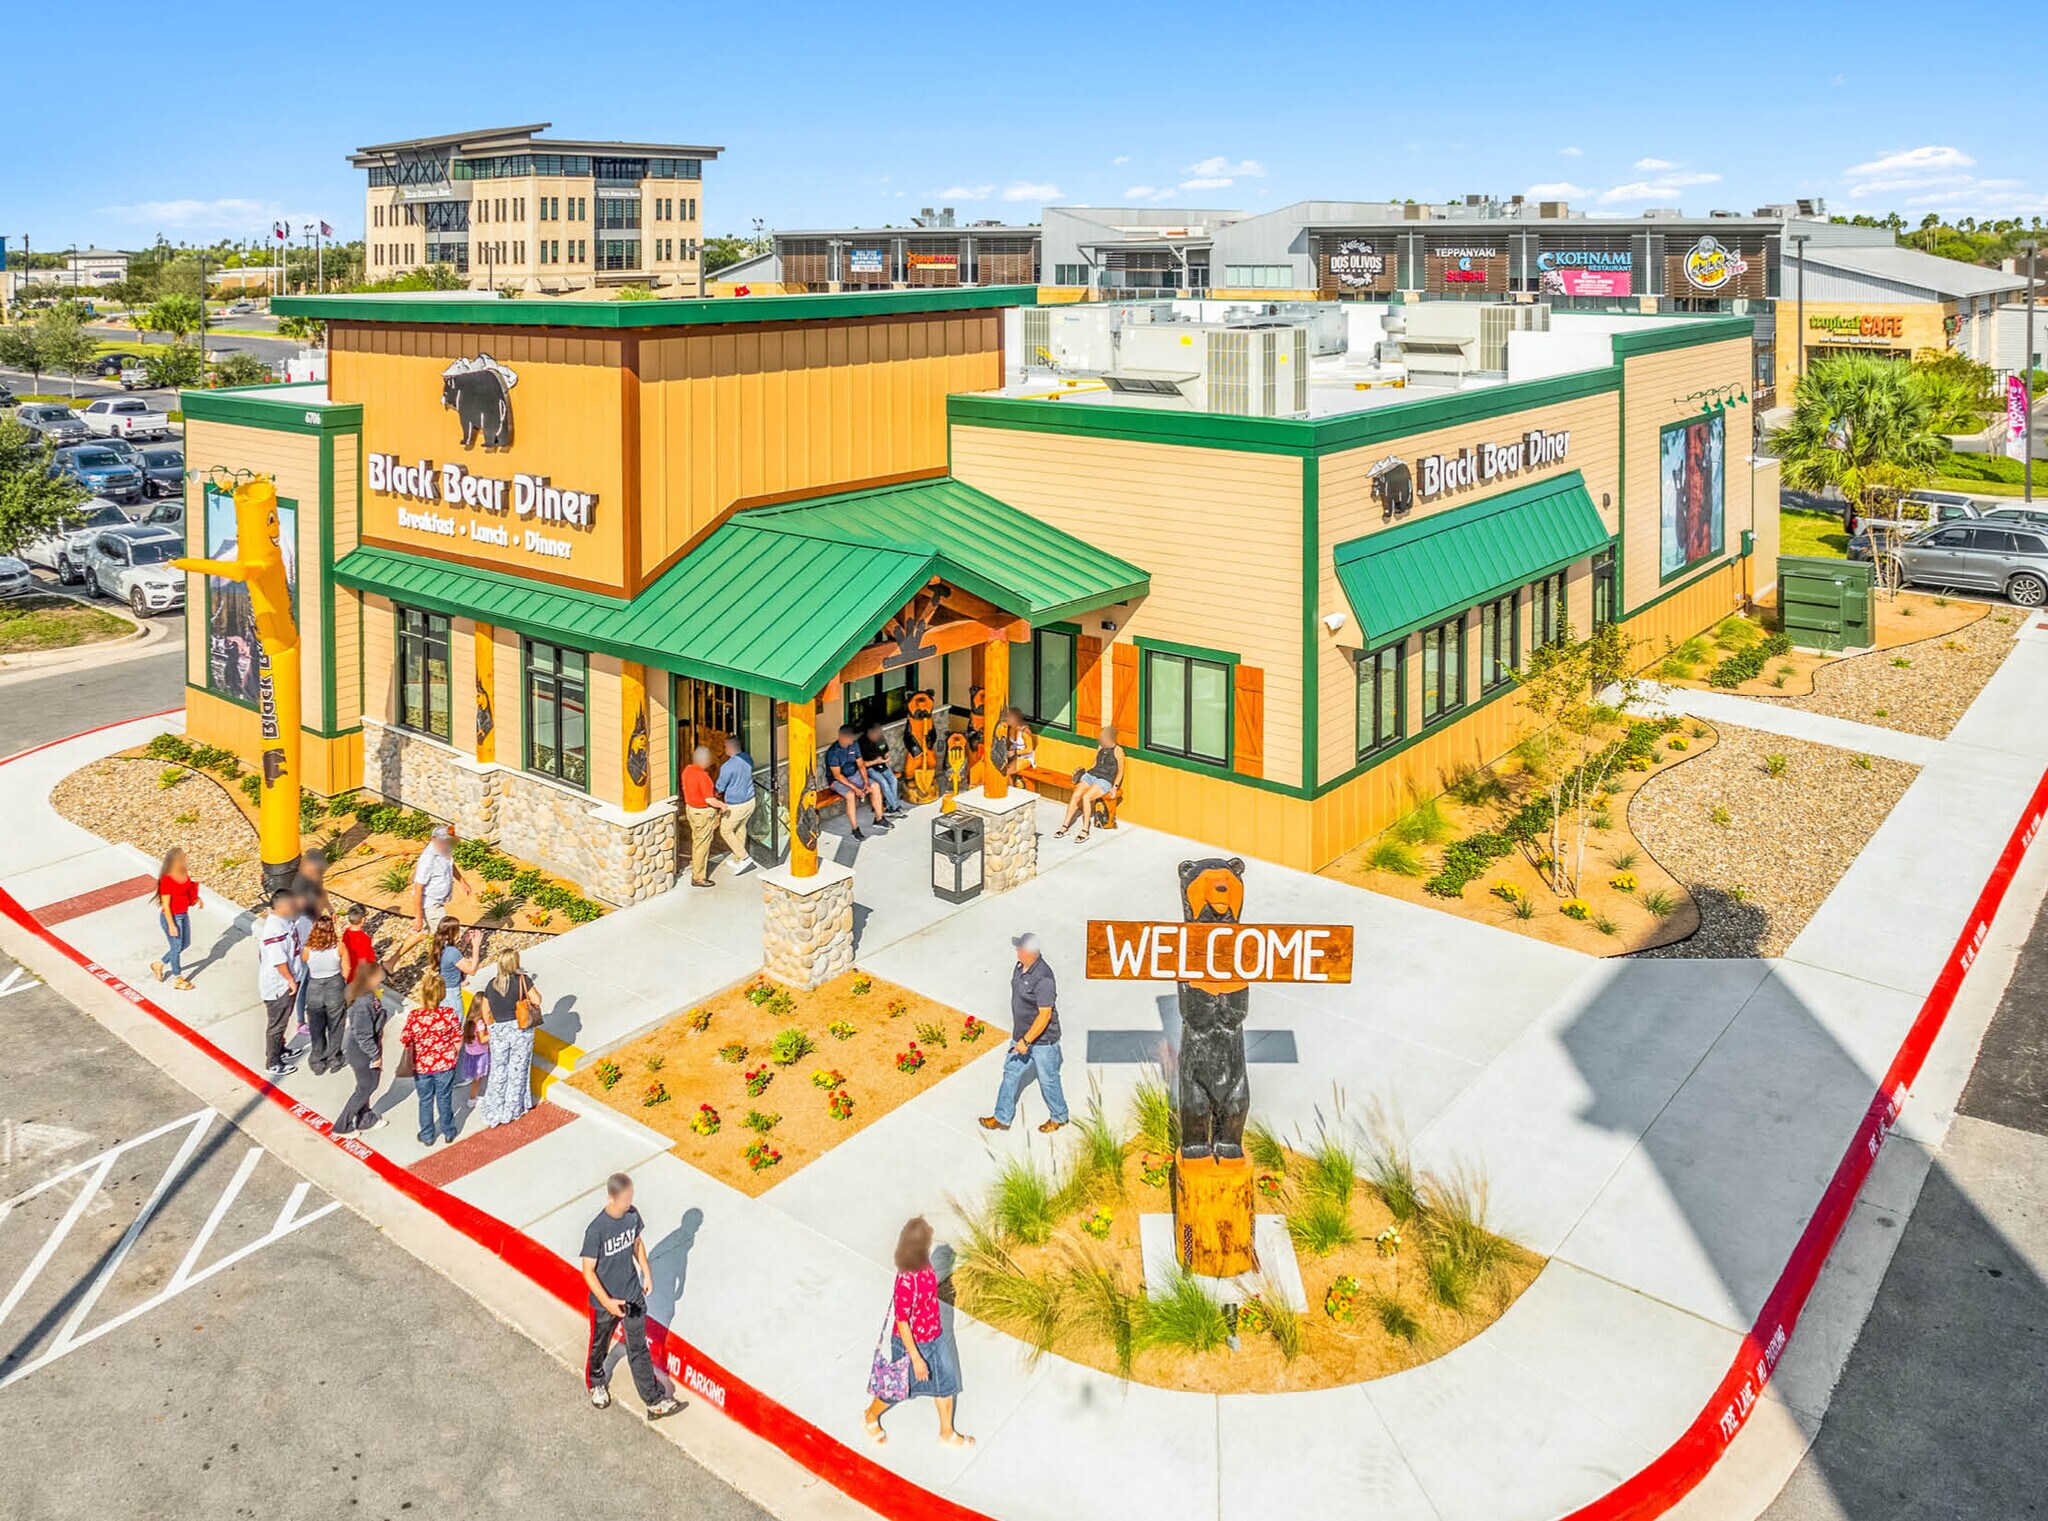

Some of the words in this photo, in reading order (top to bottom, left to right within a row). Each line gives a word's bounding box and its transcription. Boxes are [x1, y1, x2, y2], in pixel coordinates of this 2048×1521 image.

[1331, 256, 1349, 269] DOS
[1350, 255, 1382, 269] OLIVOS
[1435, 248, 1496, 258] TEPPANYAKI
[1445, 270, 1485, 282] SUSHI
[1556, 252, 1632, 265] KOHNAMI
[1810, 314, 1860, 331] tropical
[1860, 315, 1903, 337] CAFE
[368, 452, 438, 500] Black
[442, 463, 507, 511] Bear
[513, 473, 595, 527] Diner
[1423, 448, 1479, 497] Black
[1484, 442, 1525, 479] Bear
[1529, 430, 1570, 467] Diner
[397, 507, 456, 537] Breakfast
[470, 519, 509, 548] Lunch
[524, 529, 572, 559] Dinner
[260, 676, 281, 740] Black
[1105, 924, 1331, 981] WELCOME
[666, 1351, 681, 1377] NO
[684, 1364, 726, 1407] PARKING
[1720, 1404, 1739, 1441] FIRE
[1735, 1381, 1756, 1418] LANE
[1756, 1359, 1767, 1385] NO
[1764, 1323, 1786, 1369] PARKING
